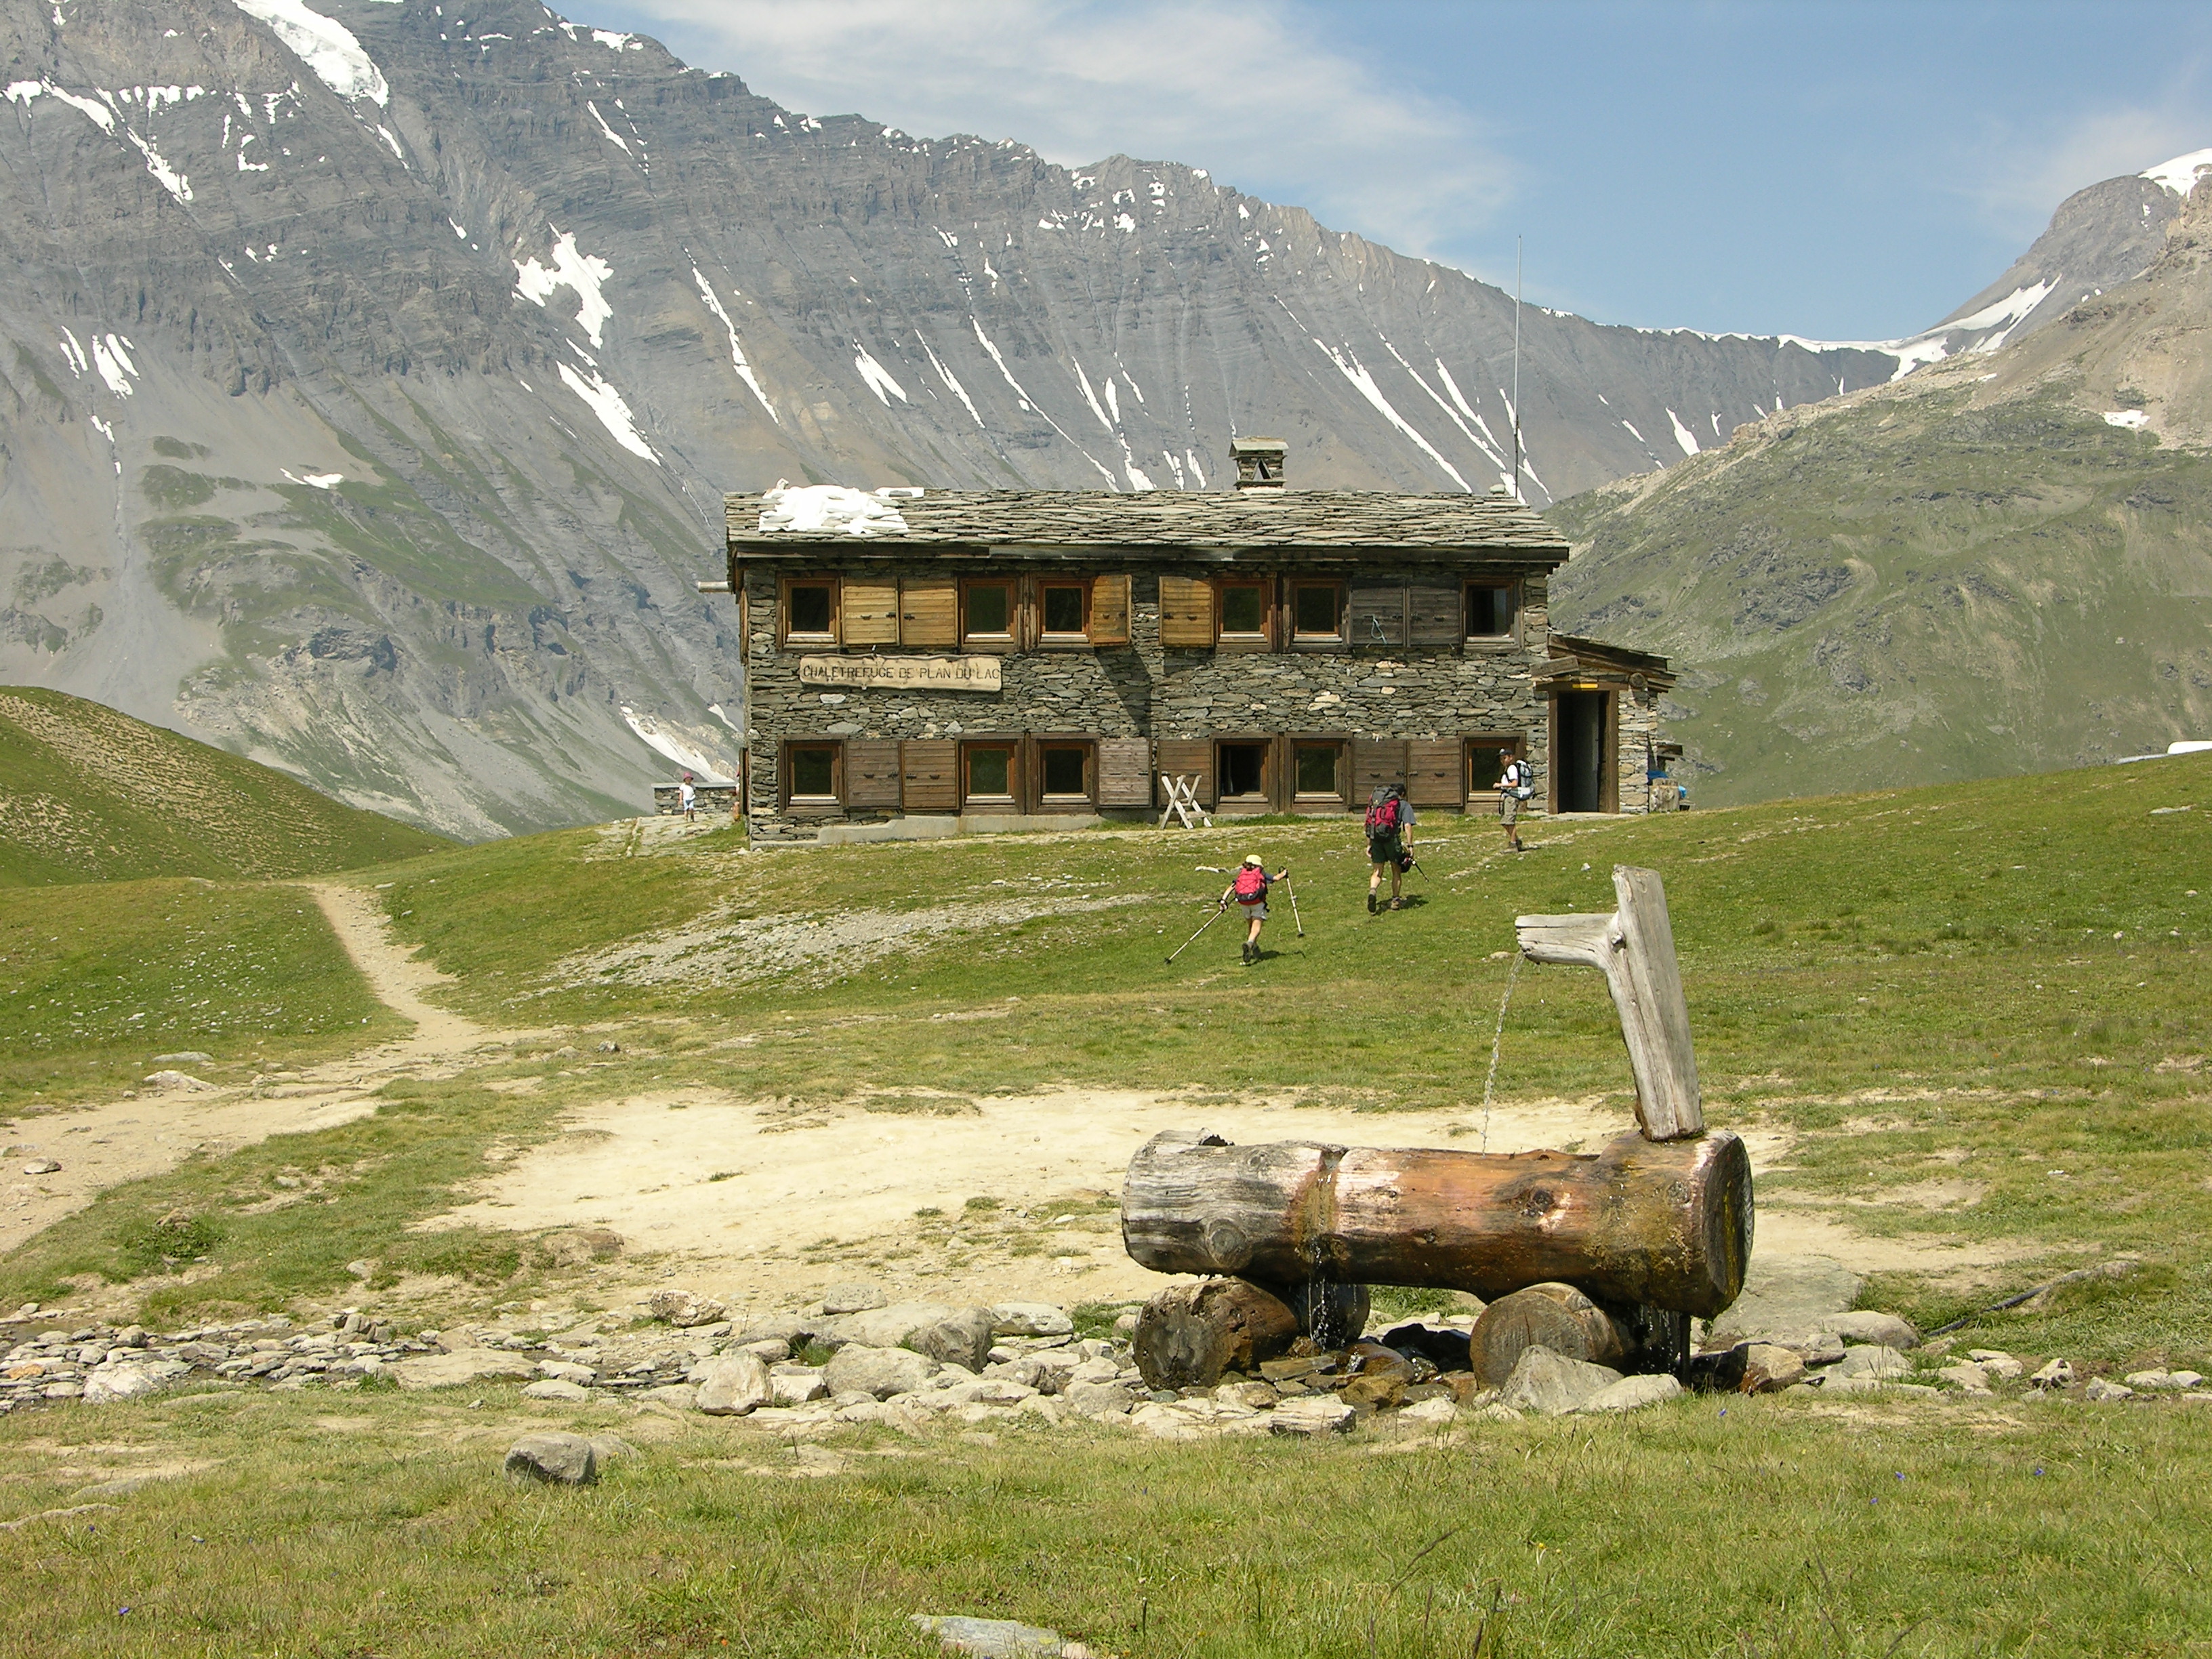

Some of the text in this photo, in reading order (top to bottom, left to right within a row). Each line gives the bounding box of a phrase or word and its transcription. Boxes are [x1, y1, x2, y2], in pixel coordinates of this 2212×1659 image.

[899, 667, 914, 678] DE
[919, 667, 951, 678] PLAN
[956, 668, 972, 679] DU
[976, 667, 1000, 679] LAC
